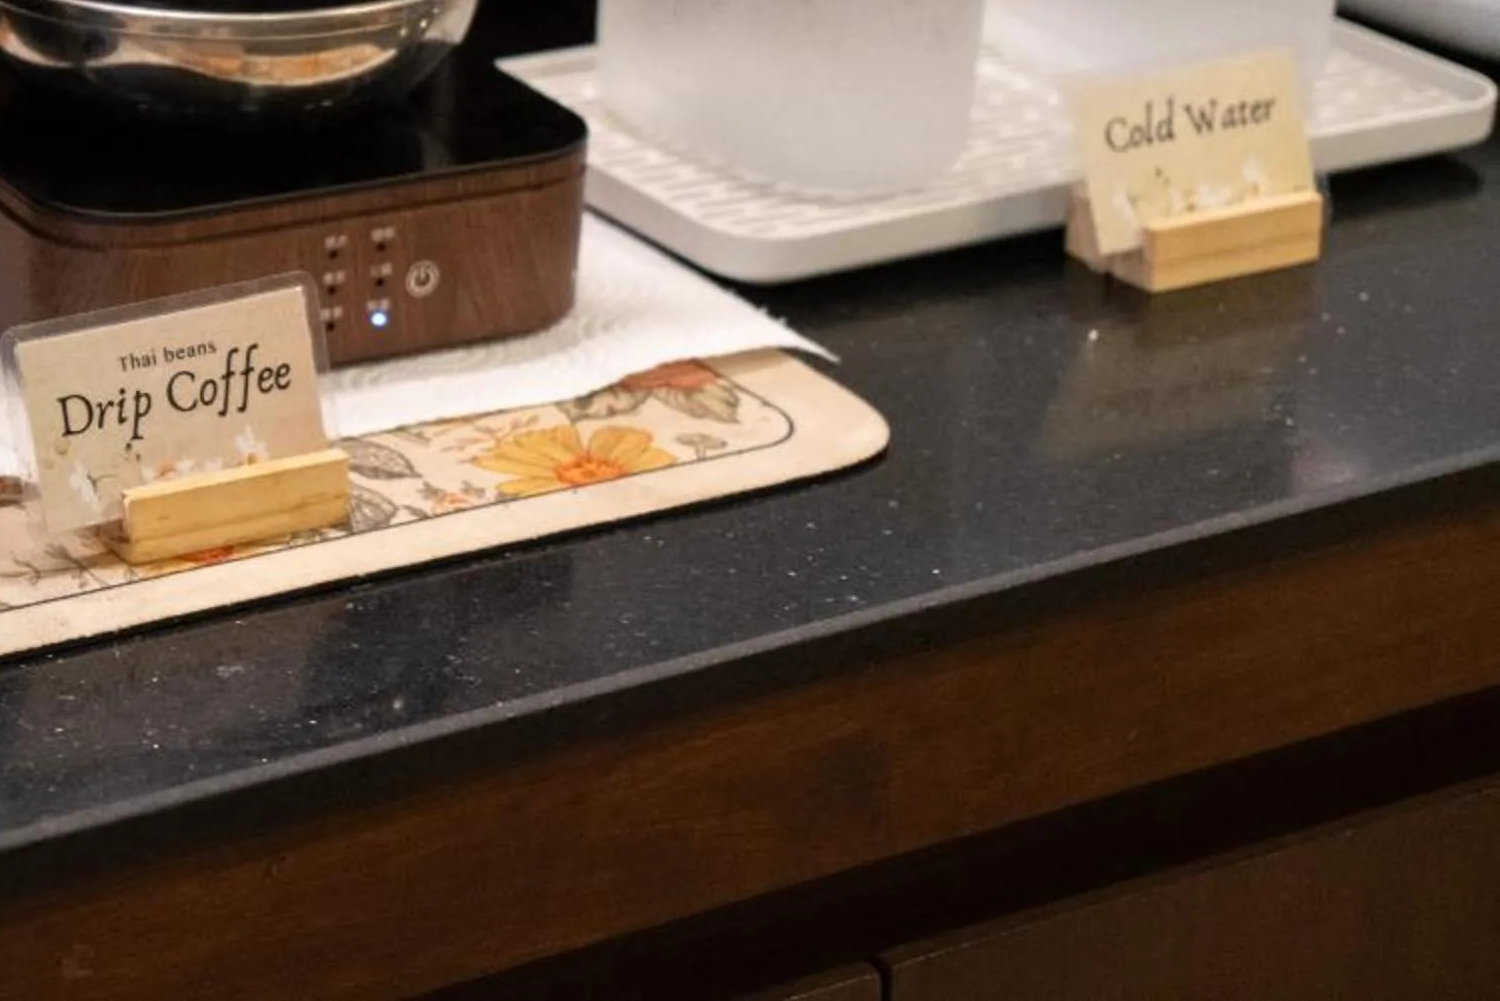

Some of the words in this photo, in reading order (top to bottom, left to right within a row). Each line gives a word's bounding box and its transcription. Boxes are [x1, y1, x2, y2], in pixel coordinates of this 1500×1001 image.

[1105, 96, 1175, 154] Cold
[1183, 98, 1276, 134] Water
[119, 354, 157, 372] Thai
[163, 340, 217, 363] beans
[57, 387, 152, 440] Drip
[166, 343, 292, 417] Coffee
